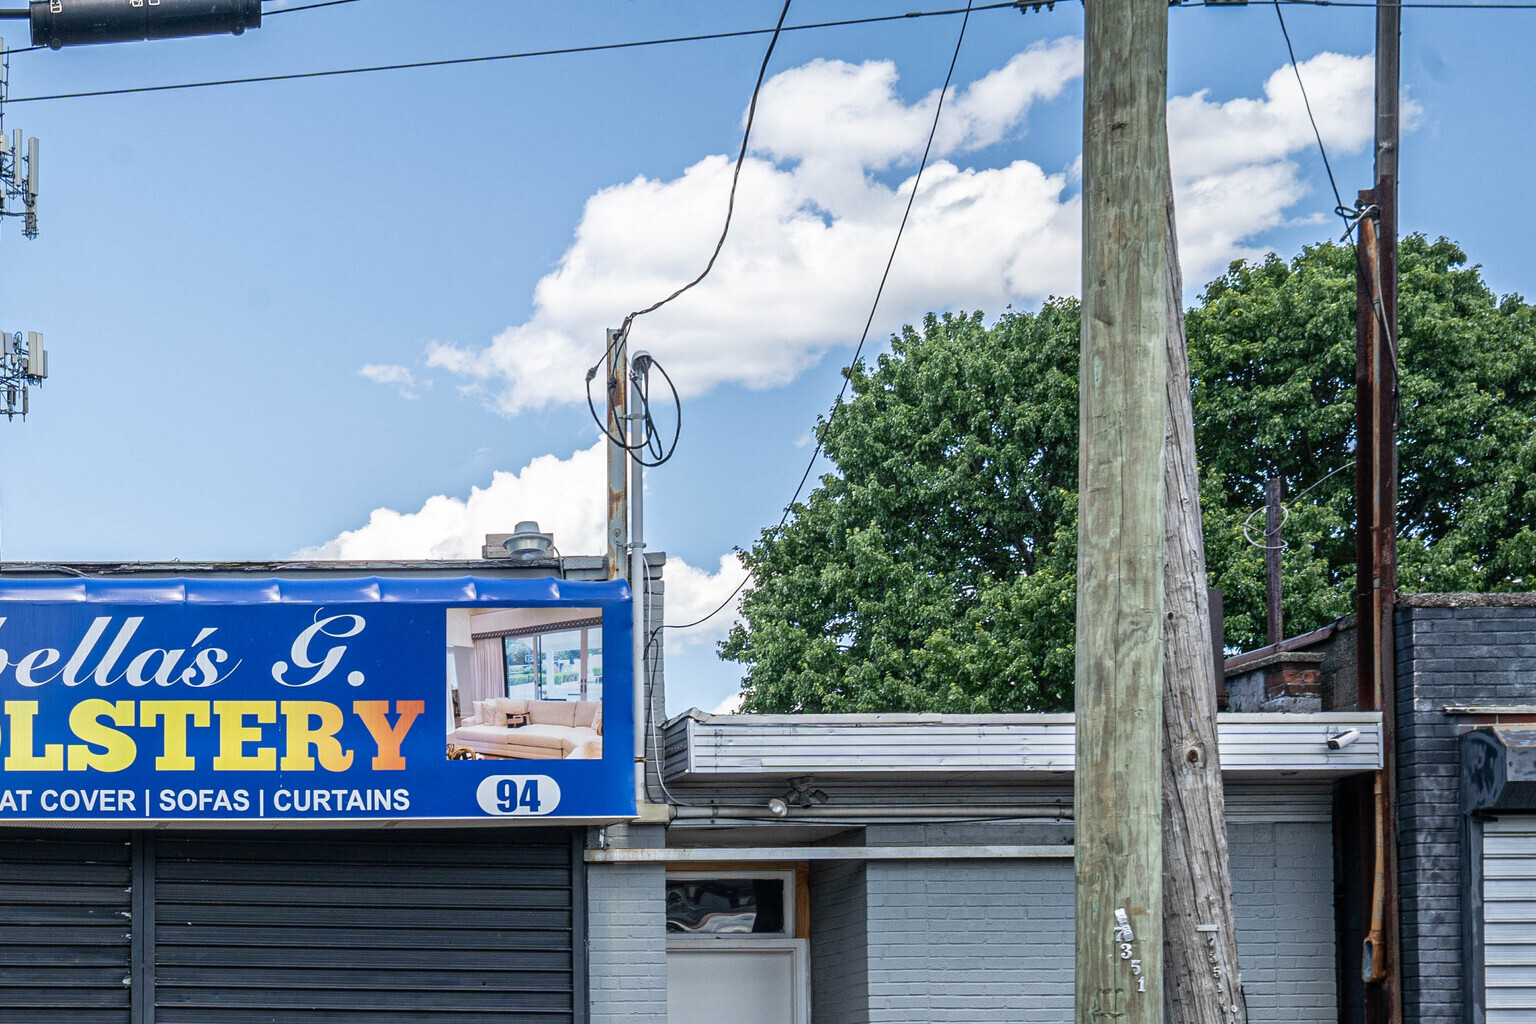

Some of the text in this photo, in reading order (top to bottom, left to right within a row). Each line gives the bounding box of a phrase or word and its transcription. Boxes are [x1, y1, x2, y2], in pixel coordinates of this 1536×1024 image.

[272, 606, 366, 688] G.
[40, 789, 137, 812] COVER
[159, 789, 250, 812] SOFAS
[273, 788, 410, 812] CURTAINS
[496, 778, 541, 813] 94
